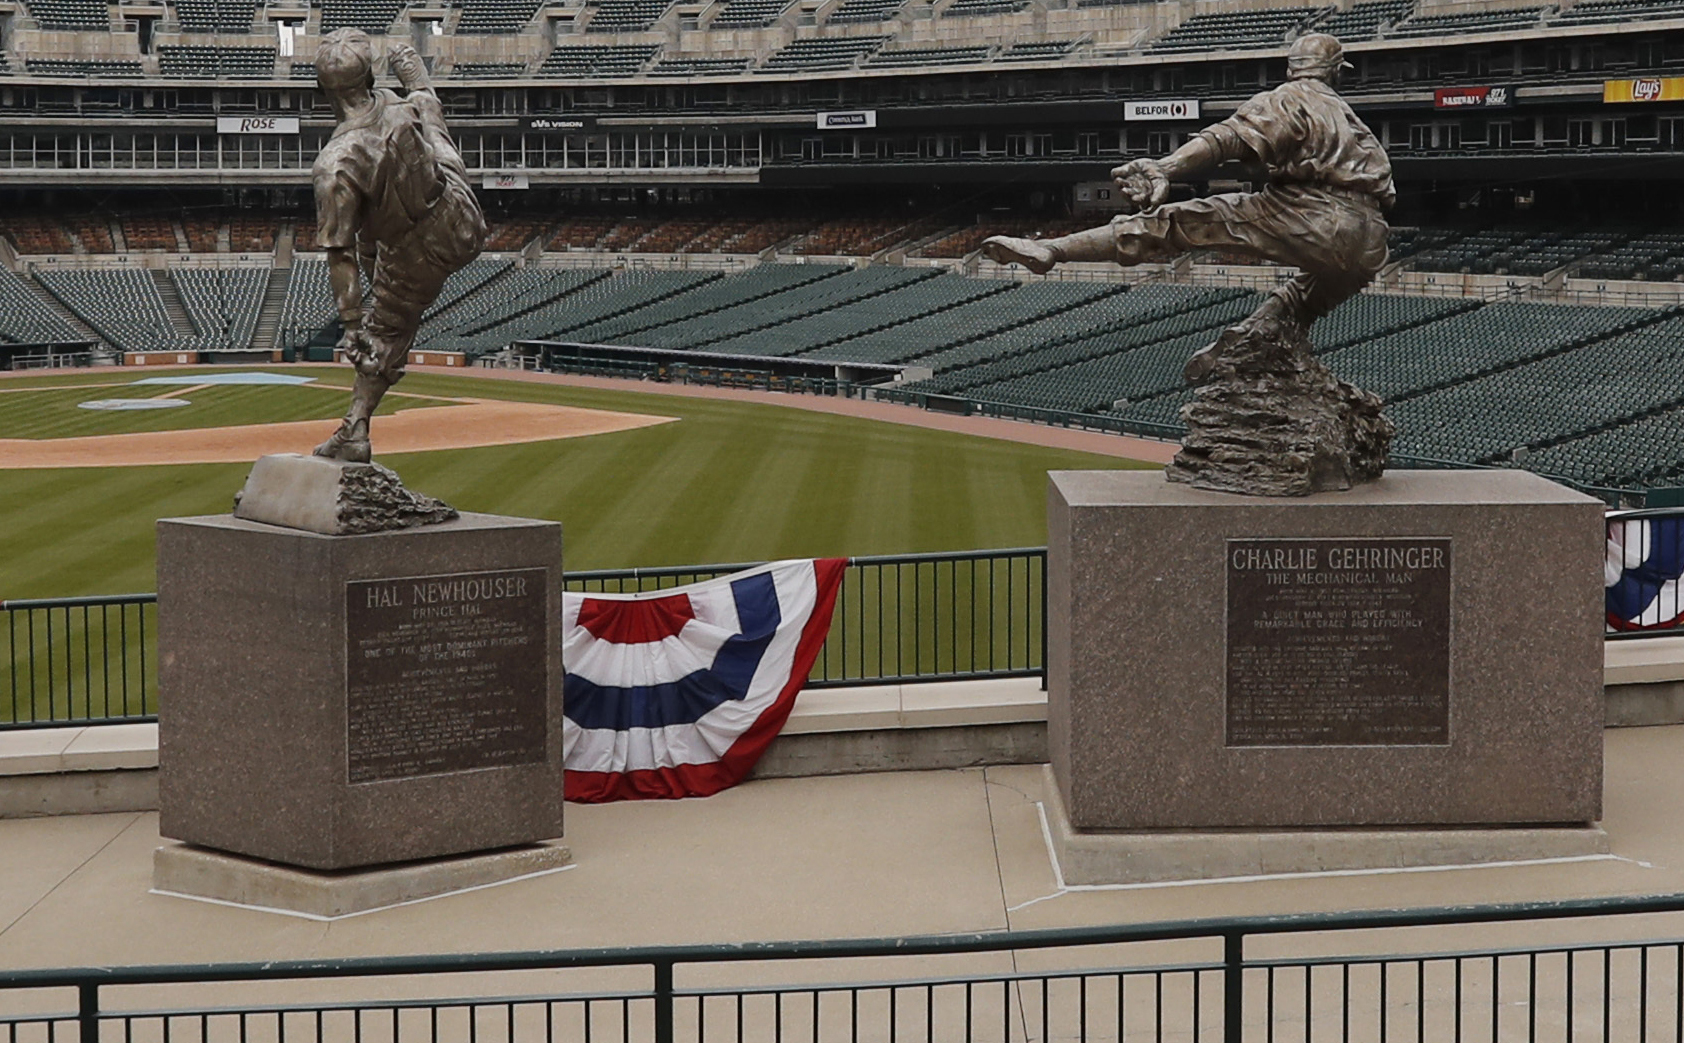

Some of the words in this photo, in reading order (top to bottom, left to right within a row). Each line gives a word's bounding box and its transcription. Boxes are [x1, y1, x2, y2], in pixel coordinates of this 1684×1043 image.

[1635, 79, 1660, 101] Lay's
[1135, 106, 1169, 115] BELFOR
[240, 118, 277, 132] ROSE
[1232, 548, 1318, 570] CHARLIE
[1328, 547, 1446, 569] GEHRINGER
[1265, 573, 1291, 585] THE
[1296, 572, 1379, 585] MECHANICAL
[1385, 572, 1414, 584] MAN
[366, 587, 403, 609] HAL
[412, 577, 529, 605] NEWHOUSER
[412, 605, 455, 620] PRINCE
[461, 603, 482, 616] HAL
[1303, 611, 1324, 619] MAN
[1328, 610, 1347, 619] WHO
[1350, 610, 1386, 619] PLAYED
[1390, 610, 1413, 619] WITH
[1316, 619, 1346, 628] GRACE
[1350, 619, 1369, 628] AND
[1372, 618, 1424, 628] EFFICIENCY
[364, 648, 381, 658] ONE
[385, 648, 397, 657] OF
[401, 646, 416, 656] THE
[419, 643, 442, 654] MOST
[446, 640, 488, 652] DOMINANT
[490, 636, 530, 648] PITCHERS
[418, 653, 429, 662] OF
[434, 652, 449, 661] THE
